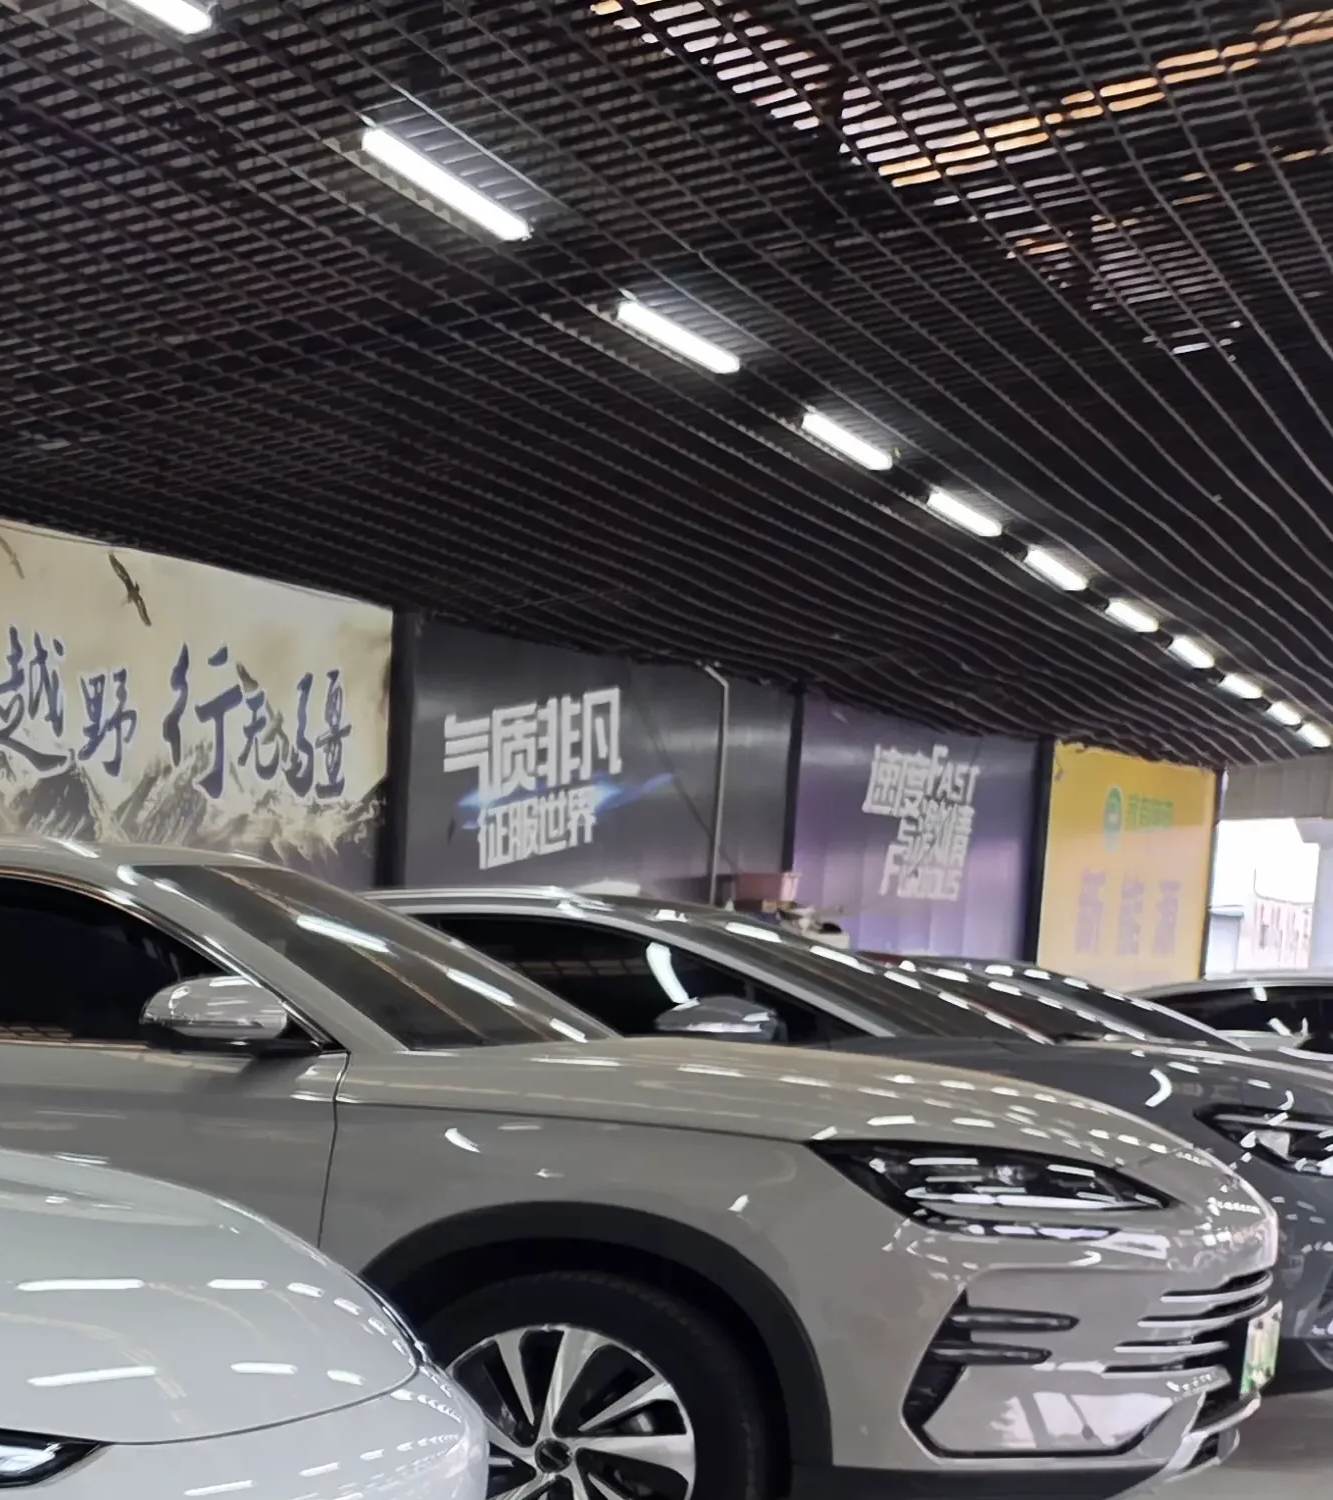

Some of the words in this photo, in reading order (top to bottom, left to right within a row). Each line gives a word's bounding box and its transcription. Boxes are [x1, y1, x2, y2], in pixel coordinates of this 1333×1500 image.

[443, 686, 622, 801] 气质非凡
[477, 783, 597, 869] 征服世界
